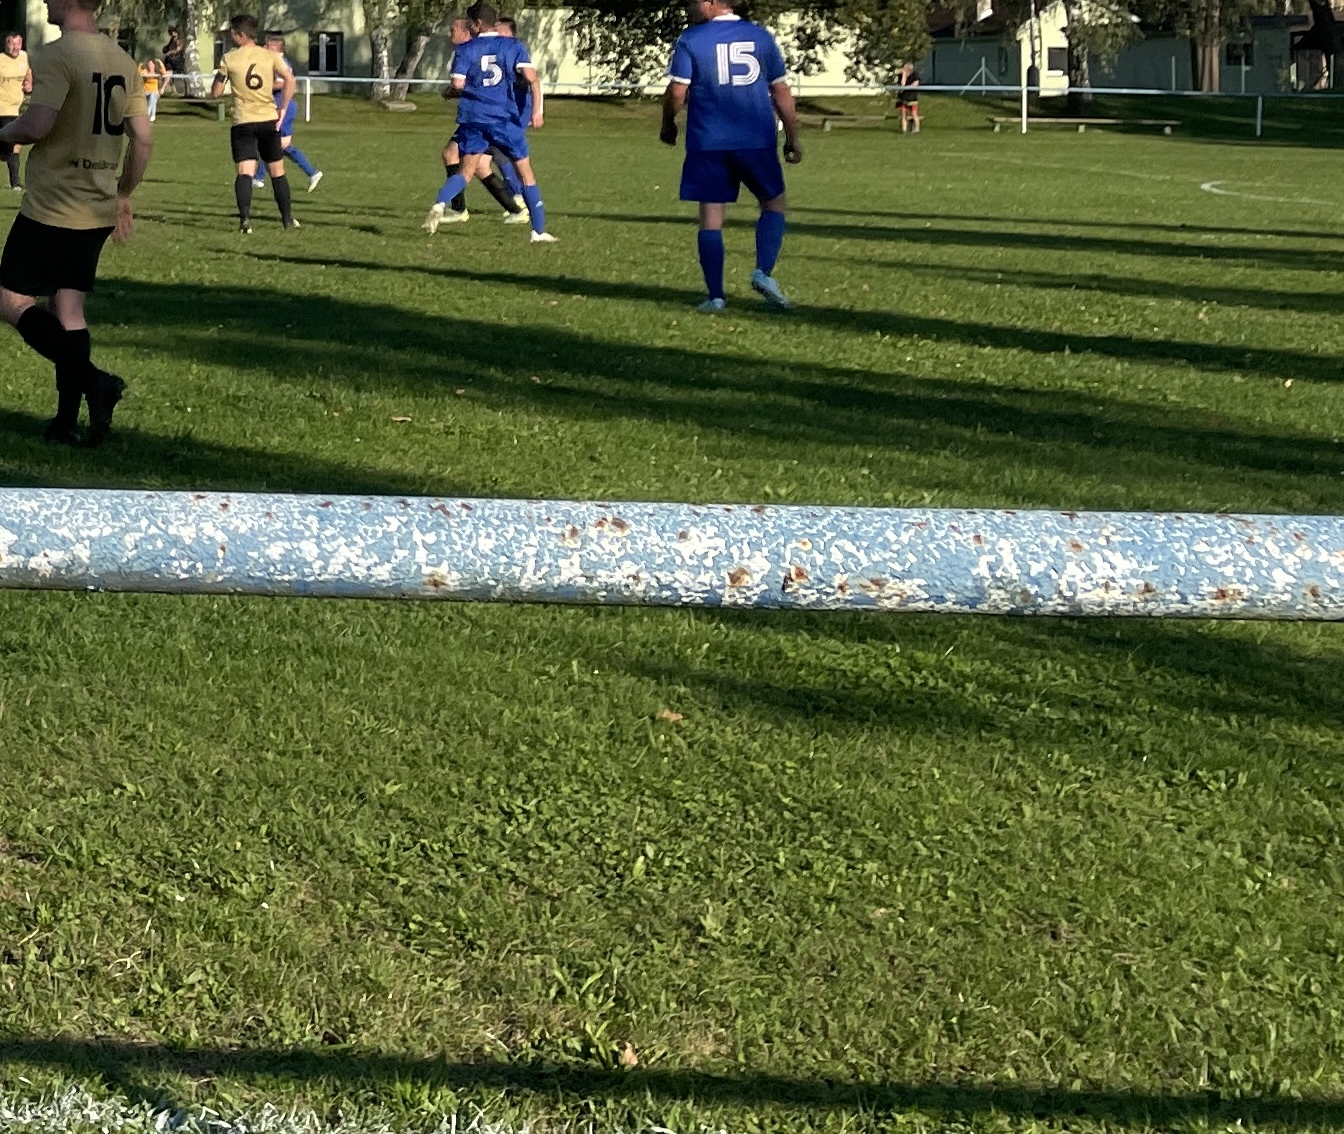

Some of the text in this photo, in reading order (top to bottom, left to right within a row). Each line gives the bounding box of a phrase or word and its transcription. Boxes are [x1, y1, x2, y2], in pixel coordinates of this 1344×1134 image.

[246, 63, 264, 91] 6
[481, 54, 503, 87] 5
[716, 41, 761, 86] 15
[91, 71, 126, 135] 10
